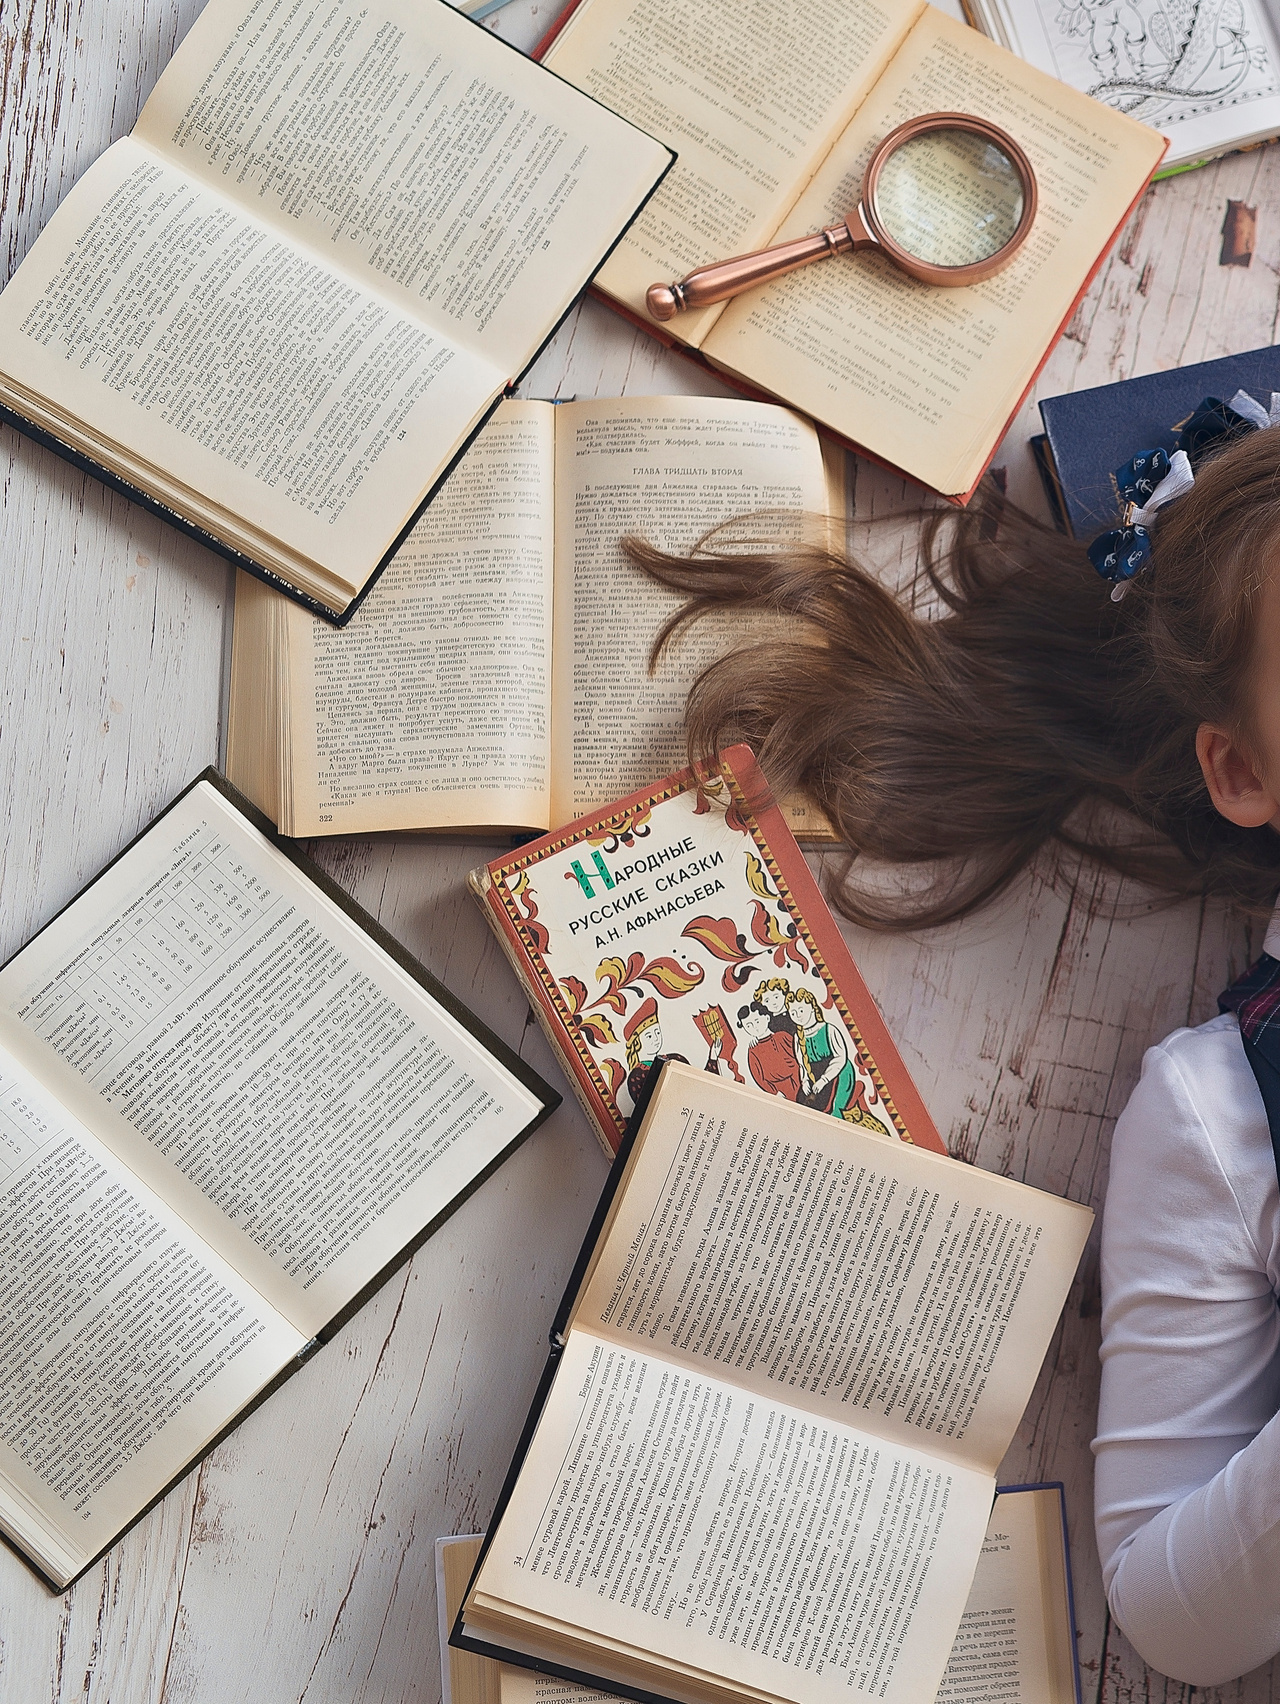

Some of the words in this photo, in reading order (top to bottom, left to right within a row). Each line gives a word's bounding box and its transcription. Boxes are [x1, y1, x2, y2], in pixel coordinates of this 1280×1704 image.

[62, 306, 83, 331] Хотите
[81, 267, 109, 305] посмотреть
[107, 219, 144, 266] представление
[147, 192, 166, 213] цирке?
[283, 452, 307, 483] Джемма
[313, 400, 343, 440] договорила,
[340, 361, 369, 398] продолжая
[367, 342, 385, 361] молча
[396, 429, 407, 442] 124
[632, 467, 661, 475] ГЛАВА
[663, 467, 708, 476] ТРИДЦАТЬ
[711, 468, 743, 476] ВТОРАЯ
[328, 755, 347, 763] «Что
[359, 751, 385, 761] мной?»
[402, 749, 427, 758] страхе
[428, 747, 464, 756] подумала
[466, 745, 503, 753] Анжелика.
[318, 814, 333, 823] 322
[172, 828, 201, 854] Таблица
[201, 819, 208, 827] 5
[570, 836, 696, 899] НАРОДНЫЕ
[568, 887, 648, 935] РУССКИЕ
[655, 850, 723, 891] СКАЗКИ
[626, 879, 725, 933] АФАНАСЬЕВА
[16, 1005, 30, 1019] Доза
[30, 980, 55, 1005] облучения
[54, 947, 90, 981] инфракрасным
[90, 918, 121, 947] импульсным
[121, 896, 145, 919] лазерным
[144, 871, 171, 897] аппаратом
[54, 993, 64, 1002] Гц
[98, 1078, 118, 1096] торце
[116, 1050, 149, 1080] световода,
[146, 1027, 169, 1052] равной
[166, 1022, 174, 1030] 2
[172, 1011, 189, 1026] мВт,
[186, 972, 227, 1012] внутривенное
[225, 944, 257, 975] облучение
[255, 905, 296, 946] осуществляют
[121, 1069, 153, 1100] Методика
[151, 1047, 176, 1071] отпуска
[174, 1022, 204, 1049] процедур.
[201, 991, 235, 1022] Излучение
[233, 983, 242, 993] от
[241, 941, 288, 986] гелий-неоновых
[286, 918, 310, 942] лазеров
[494, 1105, 504, 1116] 105
[680, 1107, 690, 1118] 35
[698, 1112, 705, 1120] и
[689, 1121, 703, 1143] лица
[681, 1143, 693, 1164] цвет
[303, 1260, 319, 1276] Для
[317, 1229, 349, 1261] облучения
[348, 1200, 379, 1231] слизистой
[377, 1173, 407, 1202] оболочки
[405, 1149, 433, 1174] желудка,
[431, 1090, 489, 1149] двенадцатиперстной
[669, 1163, 686, 1196] свежий
[653, 1196, 674, 1238] сохраняя
[662, 1322, 674, 1333] В
[668, 1305, 680, 1323] свои
[676, 1261, 698, 1303] невеликие
[694, 1237, 708, 1259] годы
[702, 1206, 719, 1236] Алеша
[715, 1170, 733, 1204] казался
[729, 1151, 740, 1168] еще
[736, 1127, 749, 1149] юнее
[630, 1222, 647, 1252] Монах
[640, 1238, 658, 1266] сорока
[616, 1252, 635, 1283] Черный
[637, 1265, 649, 1279] до
[615, 1284, 622, 1292] и
[631, 1278, 642, 1293] лет
[599, 1291, 619, 1323] Пелагия
[616, 1294, 636, 1328] старятся,
[955, 1430, 965, 1440] ти
[961, 1406, 975, 1429] часам
[971, 1376, 988, 1405] вечера.
[982, 1324, 1007, 1373] Счастливый
[1001, 1270, 1027, 1323] Носачевский
[1023, 1258, 1032, 1269] на
[1028, 1242, 1037, 1256] все
[1033, 1226, 1043, 1241] это
[578, 1374, 593, 1399] Борис
[587, 1345, 601, 1374] Акунин
[72, 1492, 92, 1513] может
[92, 1461, 123, 1494] составлять
[121, 1450, 133, 1464] 3,5
[155, 1418, 168, 1432] для
[167, 1404, 182, 1418] чего
[180, 1391, 196, 1406] при
[195, 1361, 226, 1392] выходной
[226, 1332, 258, 1362] мощности
[257, 1324, 266, 1333] на
[530, 1546, 545, 1573] менее
[541, 1508, 560, 1544] суровой
[556, 1477, 572, 1506] карой.
[567, 1433, 589, 1474] Лишение
[585, 1387, 605, 1431] стипендии
[601, 1351, 617, 1385] означало,
[81, 1510, 92, 1521] 104
[677, 1594, 689, 1611] Но
[685, 1582, 695, 1594] не
[691, 1549, 707, 1580] станем
[703, 1510, 721, 1547] забегать
[717, 1476, 734, 1508] вперед.
[728, 1437, 746, 1473] История
[741, 1402, 755, 1436] достойна
[513, 1555, 524, 1568] 34
[947, 1663, 988, 1674] Виктория
[988, 1660, 1019, 1670] продол-
[535, 1684, 572, 1697] красная
[953, 1684, 989, 1694] поможет
[989, 1680, 1021, 1690] обрести
